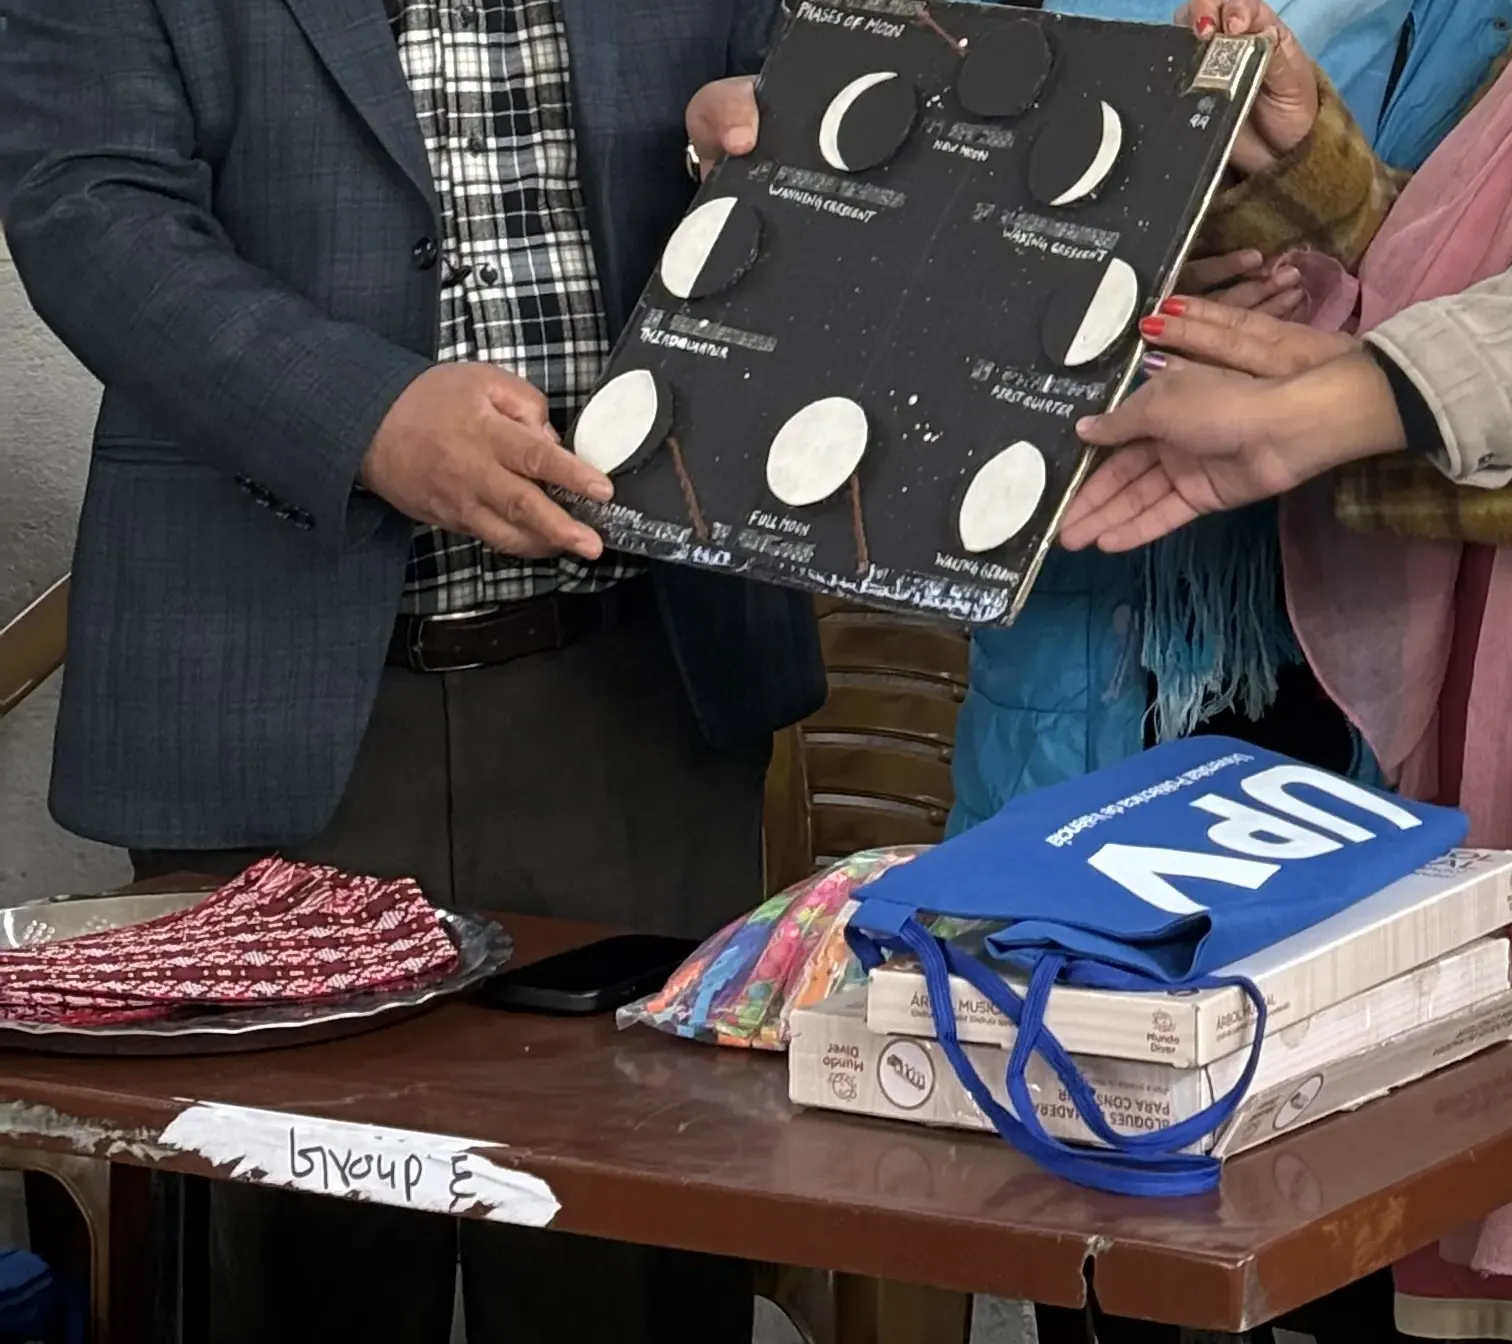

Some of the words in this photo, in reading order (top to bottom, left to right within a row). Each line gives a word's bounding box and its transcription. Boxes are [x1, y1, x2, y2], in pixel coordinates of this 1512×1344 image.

[796, 0, 842, 26] PHASES
[843, 15, 863, 29] OF
[864, 18, 906, 39] MOON
[959, 146, 989, 162] MOON
[990, 384, 1024, 405] FIRST
[1024, 393, 1075, 419] QUARTER
[748, 509, 778, 529] FULL
[779, 517, 812, 537] MOON
[1087, 764, 1423, 915] UPV
[958, 999, 1001, 1014] MUSIC
[1146, 1032, 1180, 1045] Mundo
[827, 1043, 860, 1057] Diver
[1150, 1043, 1177, 1054] Diver
[822, 1056, 864, 1072] Mundo
[1136, 1099, 1170, 1115] PARA
